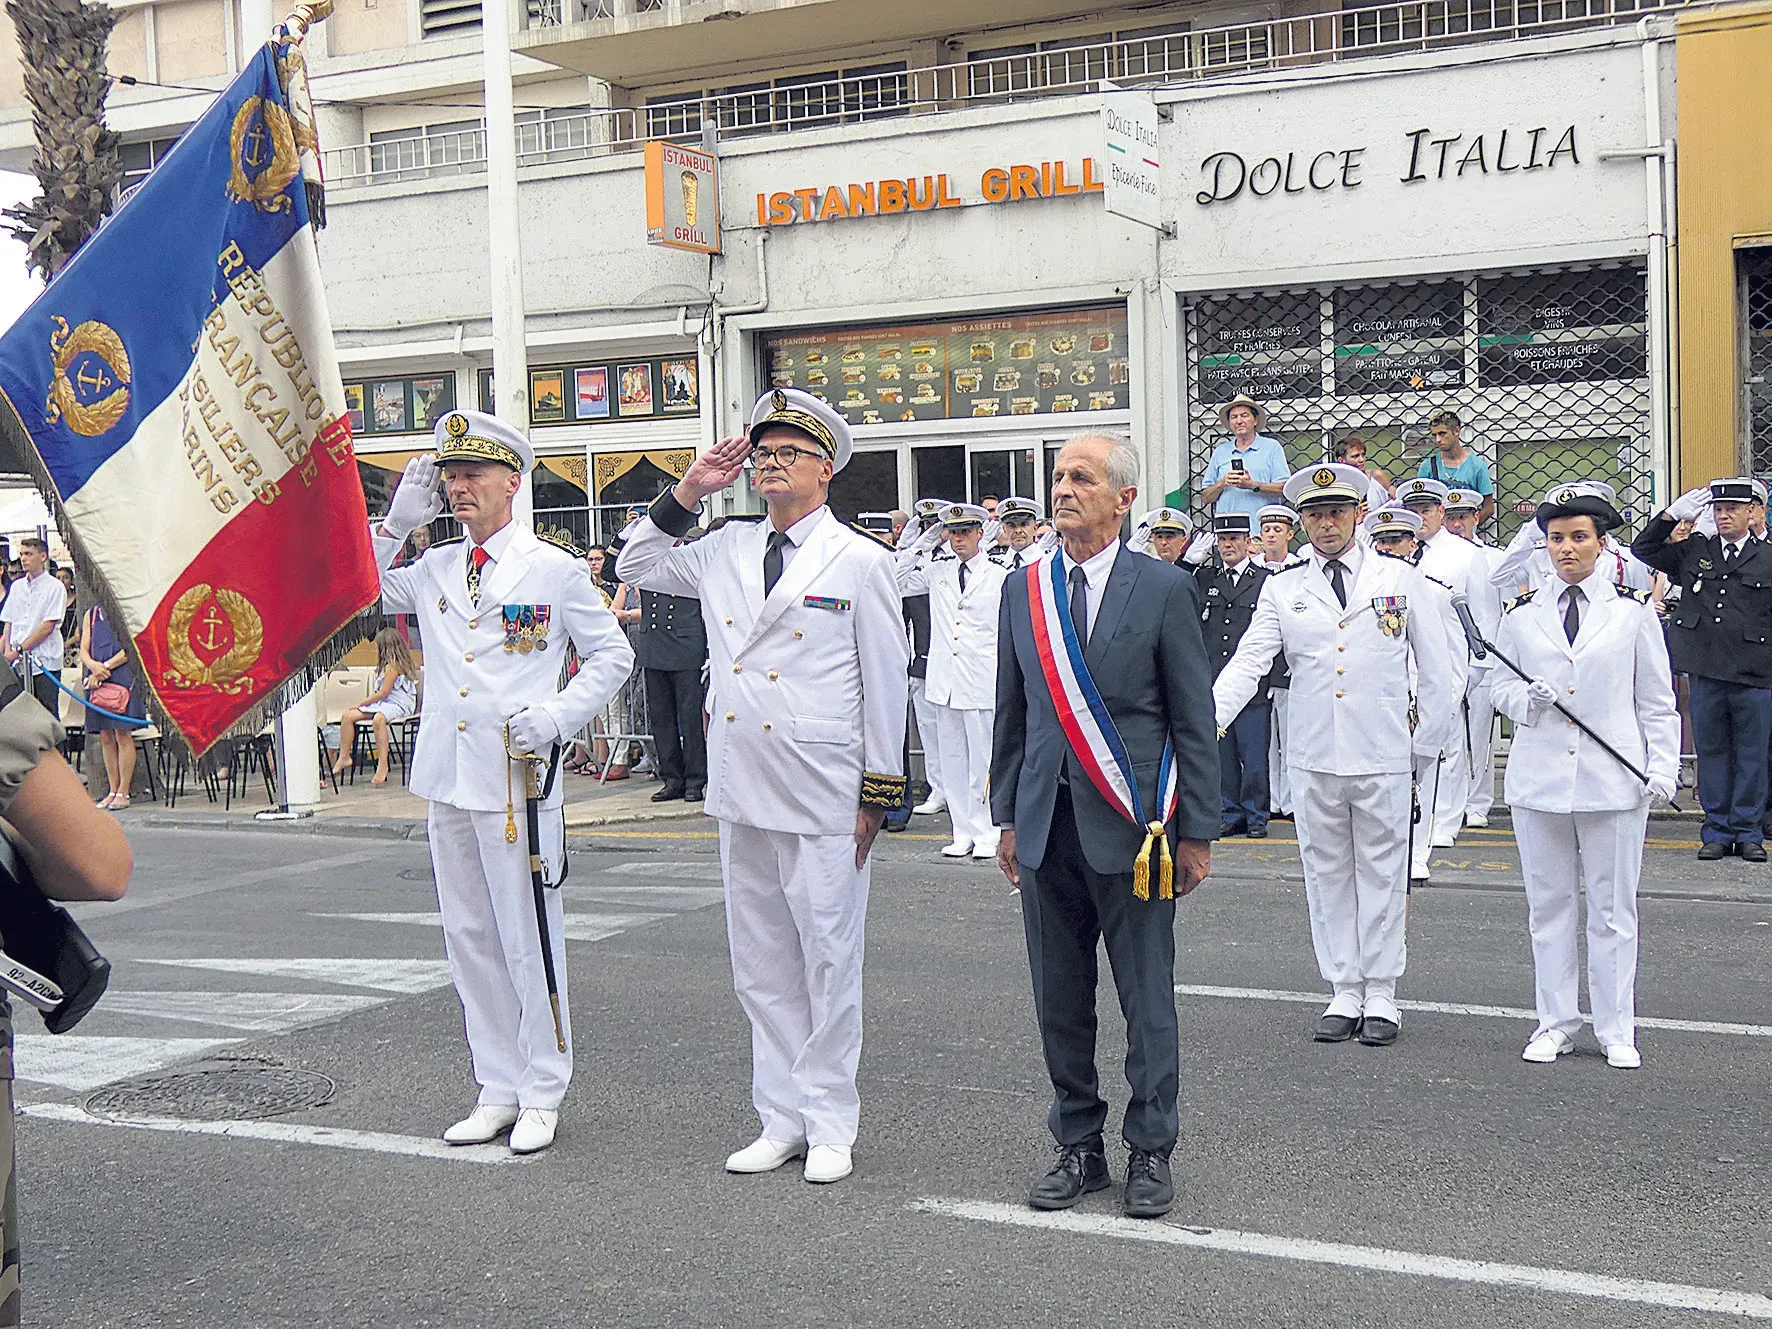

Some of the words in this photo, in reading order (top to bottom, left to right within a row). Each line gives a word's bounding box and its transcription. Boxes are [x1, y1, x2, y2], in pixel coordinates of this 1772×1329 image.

[1107, 109, 1131, 137] DOLCE
[1135, 120, 1158, 149] ITALIA
[663, 148, 712, 173] ISTANBUL
[1196, 147, 1369, 206] DOLCE
[1399, 124, 1581, 185] ITALIA
[756, 173, 961, 226] ISTANBUL
[981, 157, 1104, 202] GRILL
[674, 226, 708, 245] GRILL
[969, 321, 1012, 331] ASSIETTES
[783, 336, 826, 345] SANDWICHS
